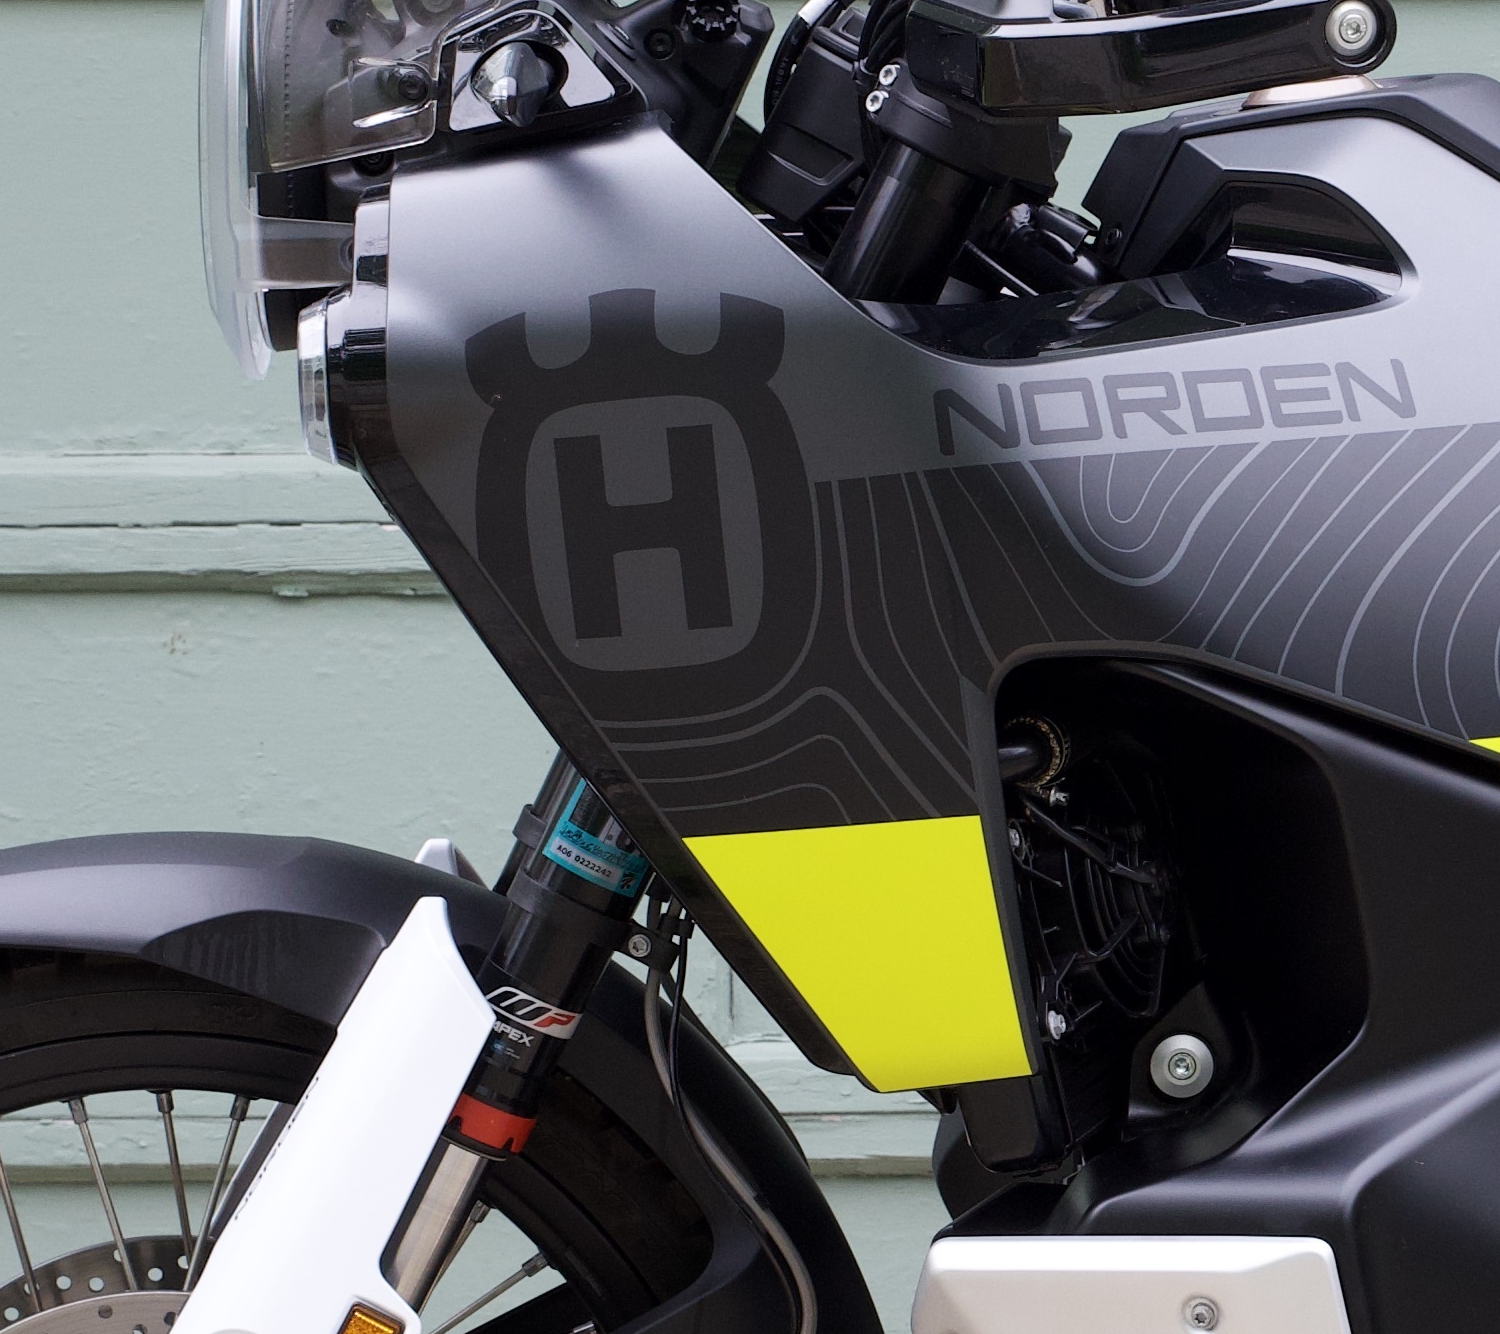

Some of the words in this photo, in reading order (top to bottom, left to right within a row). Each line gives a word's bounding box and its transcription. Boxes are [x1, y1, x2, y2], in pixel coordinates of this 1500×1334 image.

[933, 358, 1417, 456] NORDEN
[553, 423, 733, 639] H
[556, 844, 572, 859] A06
[574, 854, 613, 878] 0222242
[235, 1076, 320, 1220] NORDEN
